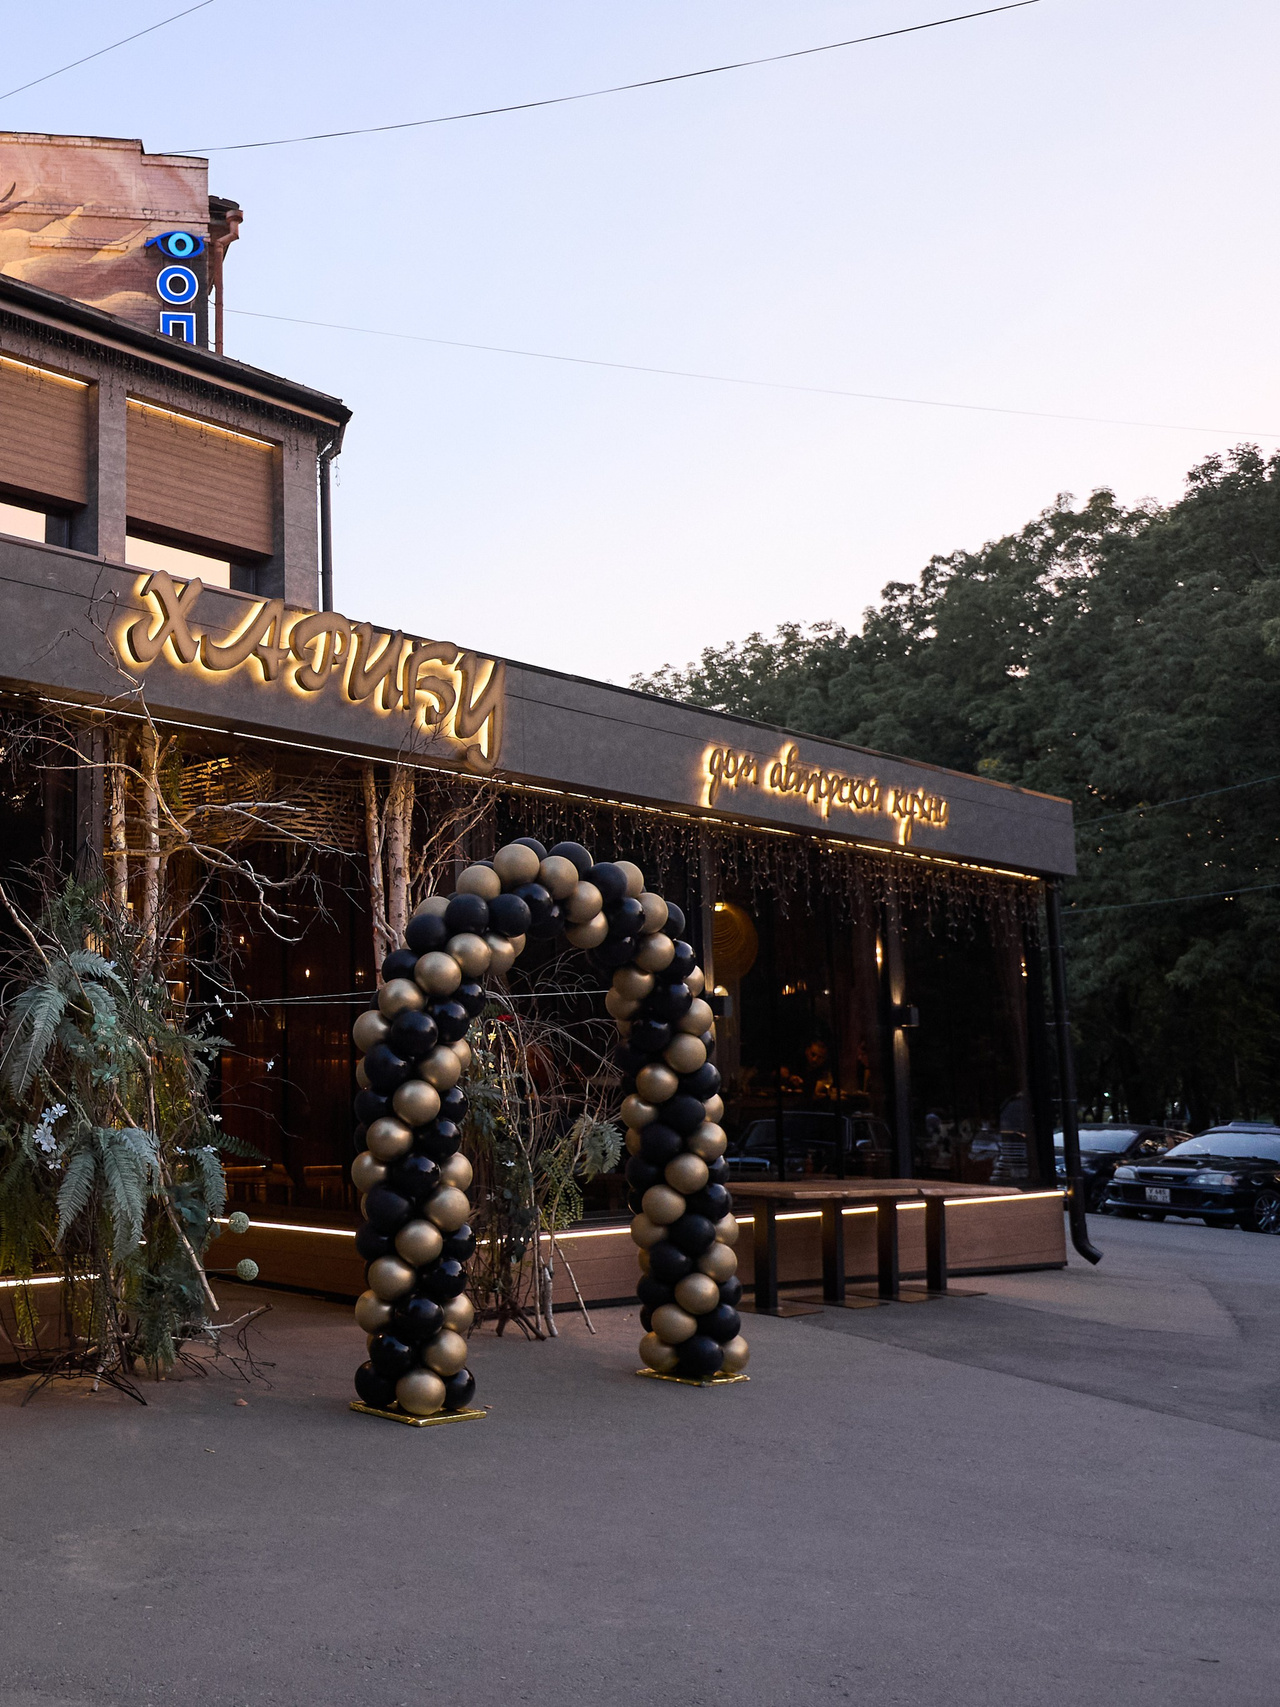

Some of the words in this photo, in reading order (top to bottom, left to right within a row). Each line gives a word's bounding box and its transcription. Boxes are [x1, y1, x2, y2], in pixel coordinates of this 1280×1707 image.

[126, 569, 507, 773] ХАРИБУ
[708, 747, 759, 806] дом
[769, 744, 883, 818] авторской
[891, 788, 949, 846] кухни
